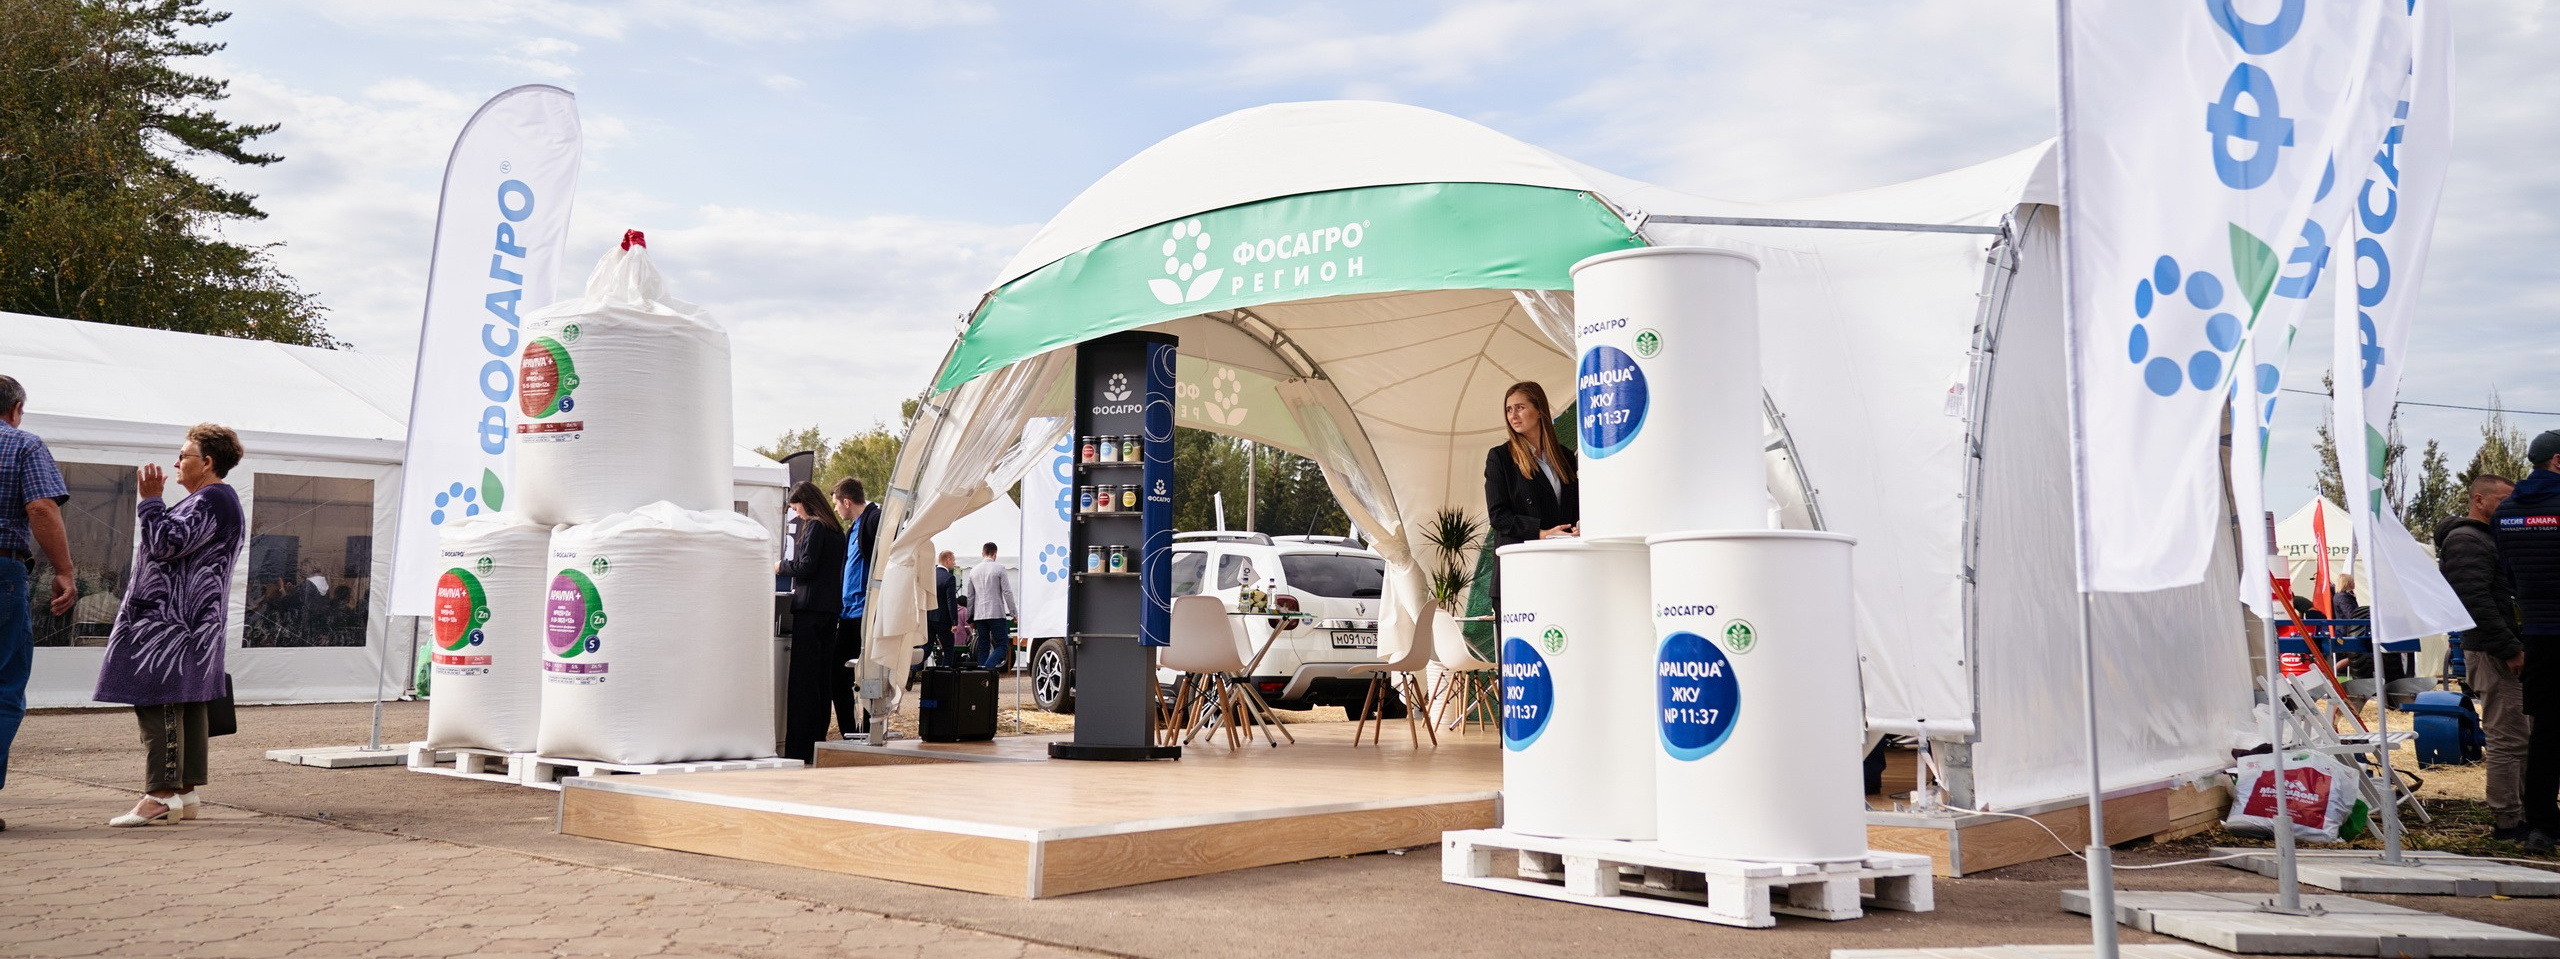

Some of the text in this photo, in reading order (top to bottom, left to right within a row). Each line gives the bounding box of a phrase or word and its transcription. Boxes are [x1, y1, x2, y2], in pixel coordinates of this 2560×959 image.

[1231, 256, 1363, 296] РЕГИОН
[1583, 318, 1626, 335] ФОСАГРО
[1590, 393, 1614, 409] ЖКУ
[1092, 404, 1143, 415] ФОСАГРО
[1584, 409, 1631, 429] NP 11:37
[1147, 495, 1171, 503] ФОСАГРО
[478, 611, 489, 619] Zn
[1663, 605, 1715, 616] ФОСАГРО
[594, 616, 605, 625] Zn
[473, 634, 479, 642] S
[589, 640, 595, 649] S
[1659, 661, 1722, 681] APALIQUA
[1671, 686, 1700, 702] ЖКУ
[1511, 705, 1538, 719] 11:37
[1664, 708, 1719, 724] NP 11:37
